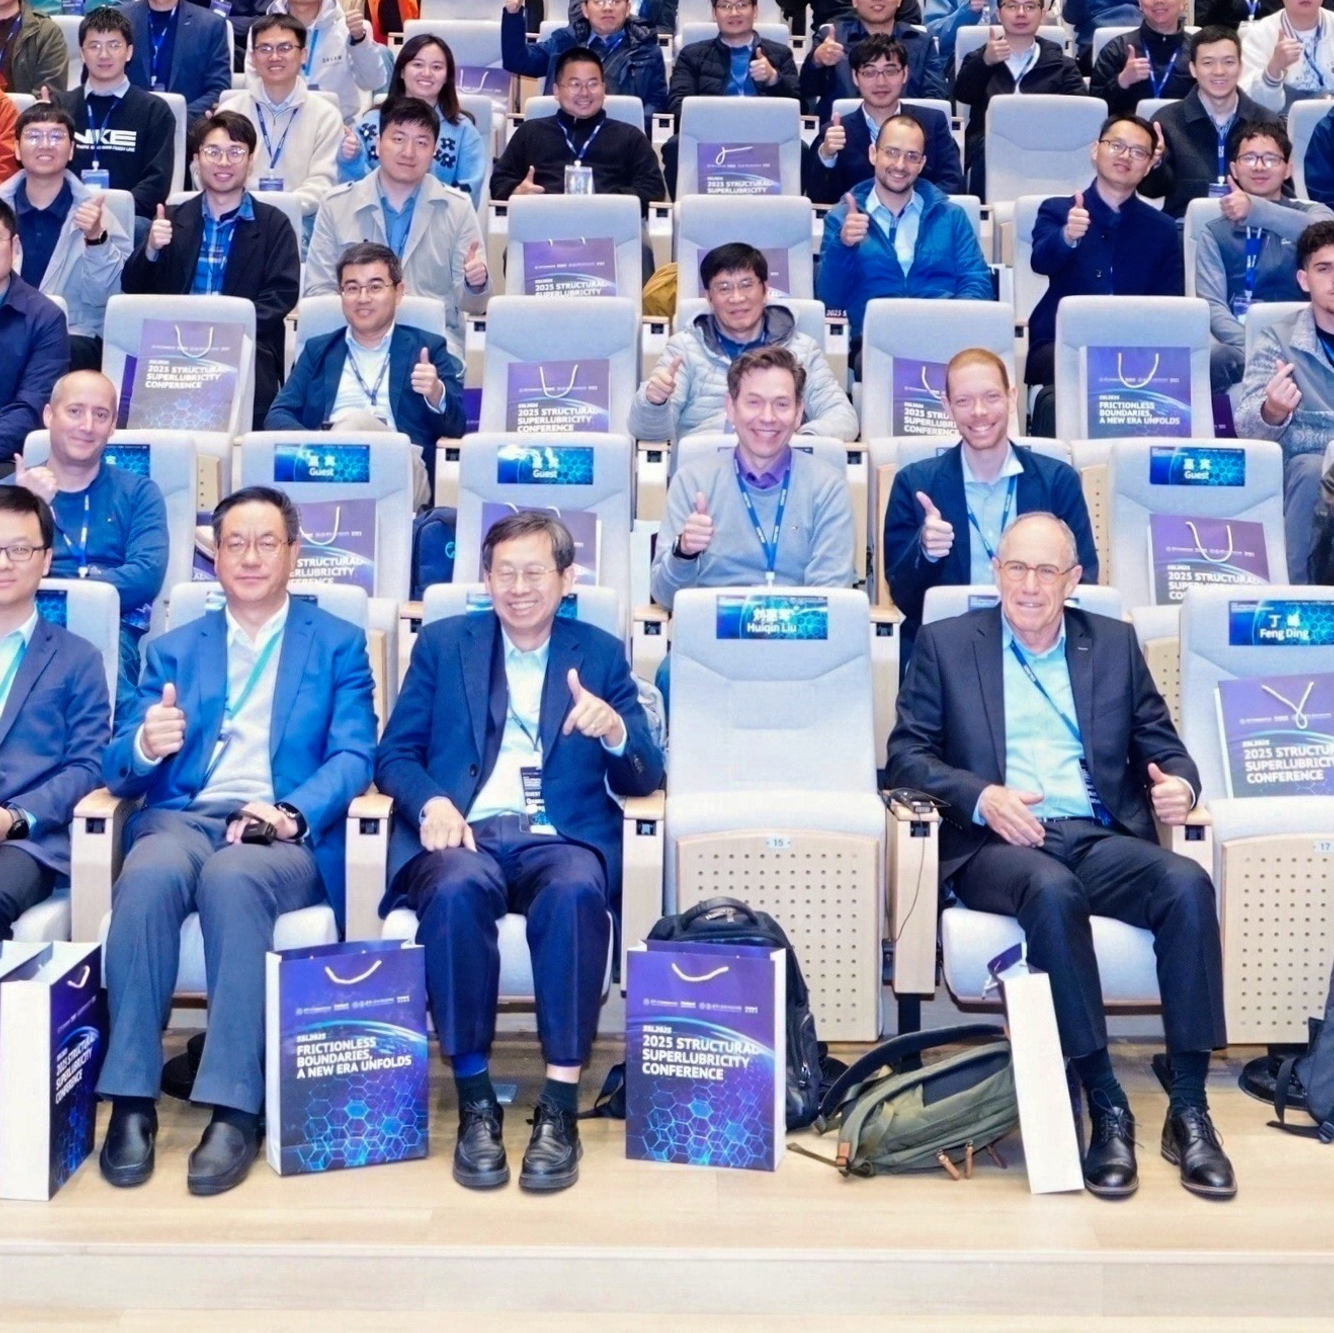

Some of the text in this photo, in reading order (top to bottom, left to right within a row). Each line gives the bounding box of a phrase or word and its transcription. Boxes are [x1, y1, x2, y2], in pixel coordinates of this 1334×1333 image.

[518, 408, 539, 417] 2025
[904, 408, 925, 417] 2025
[517, 416, 592, 426] SUPERLUBRICITY
[1144, 417, 1180, 425] UNFOLDS
[309, 467, 334, 477] Guest
[532, 469, 558, 479] Guest
[1184, 470, 1209, 480] Guest
[297, 557, 363, 567] STRUCTURAL
[1168, 571, 1192, 581] 2025
[747, 622, 797, 634] Huiqin Liu
[1260, 628, 1309, 641] Feng Ding
[1244, 747, 1273, 761] 2025
[1247, 769, 1324, 785] CONFERENCE
[297, 1037, 376, 1056] FRICTIONLESS
[643, 1034, 760, 1055] 2025 STRUCTURAL
[297, 1049, 373, 1068] BOUNDARIES,
[642, 1048, 750, 1068] SUPERLUBRICITY
[296, 1055, 412, 1079] A NEW ERA UNFOLDS
[642, 1062, 724, 1080] CONFERENCE
